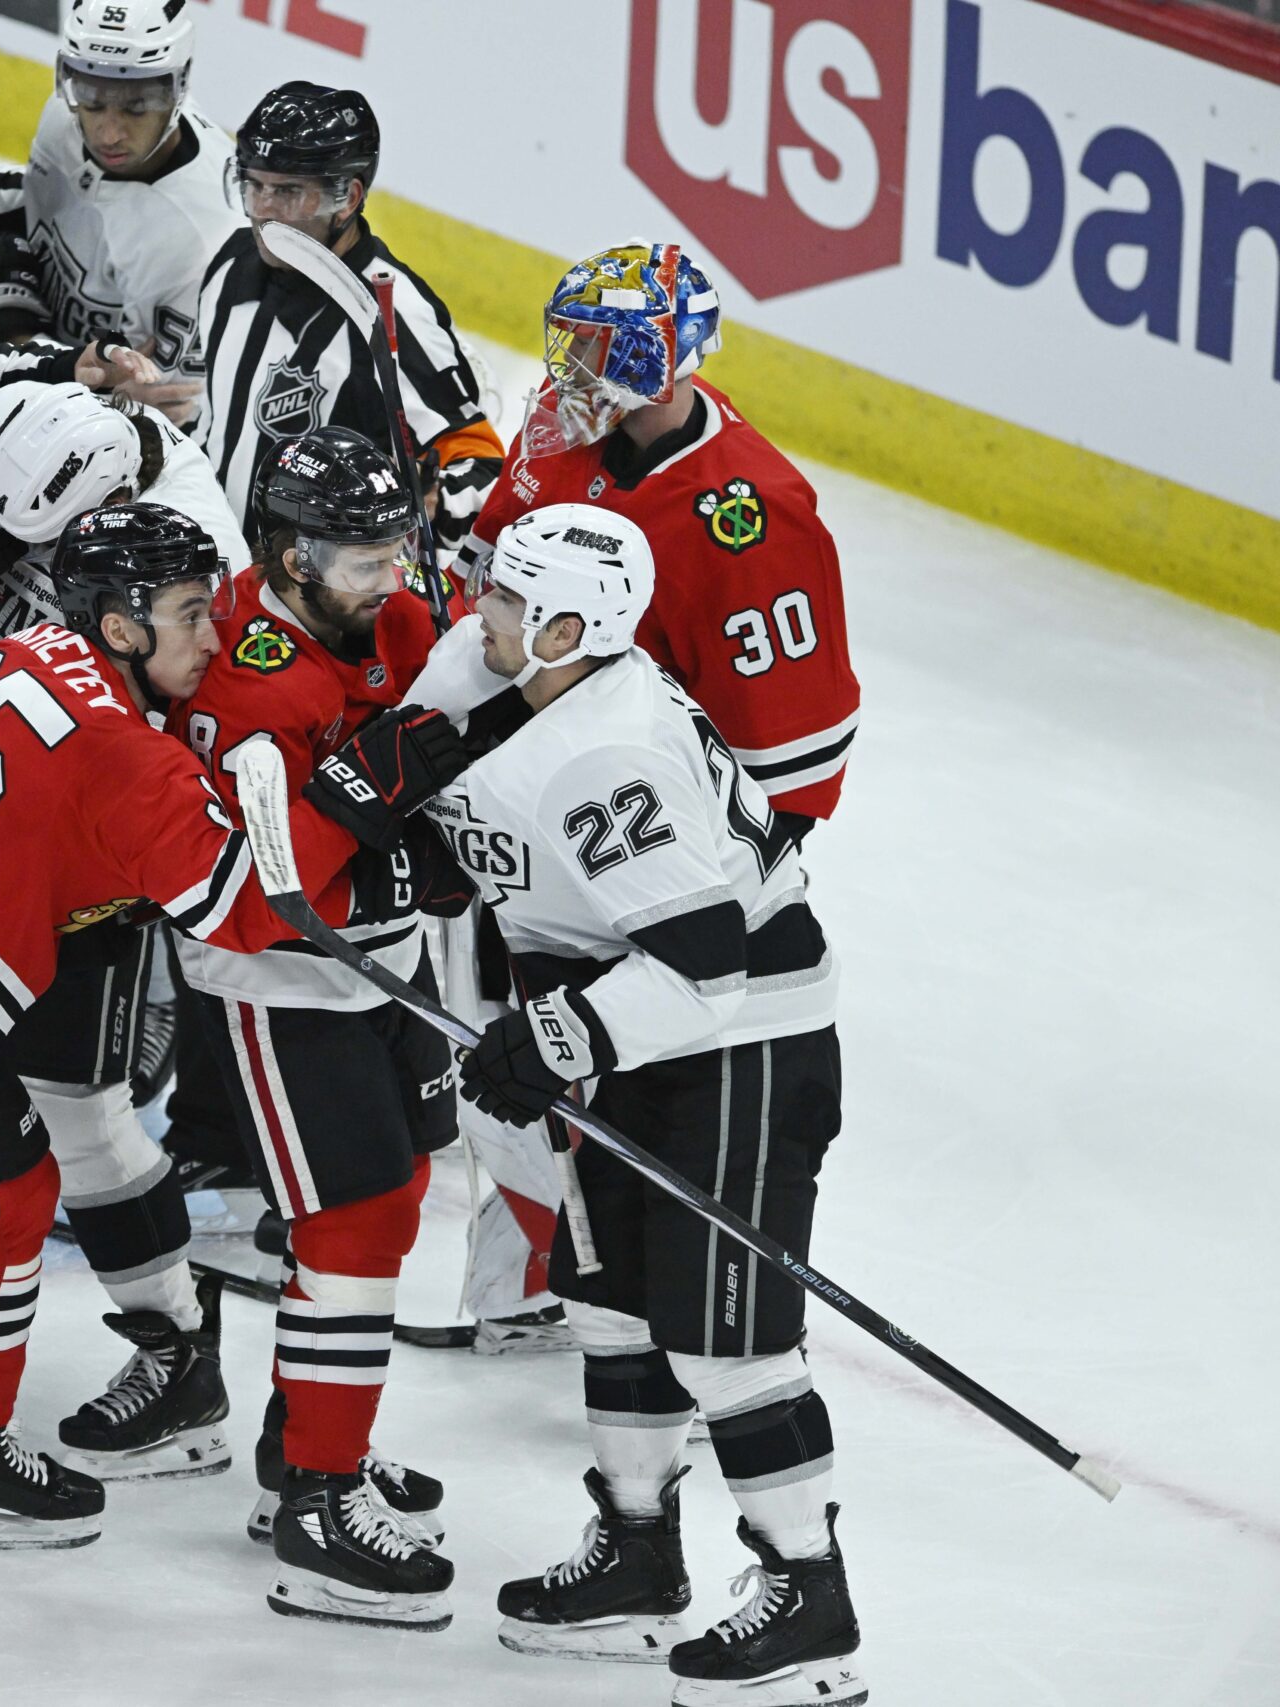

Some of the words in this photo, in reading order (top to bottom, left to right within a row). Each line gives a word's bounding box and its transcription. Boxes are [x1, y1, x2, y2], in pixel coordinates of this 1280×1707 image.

[102, 6, 128, 23] 55
[89, 43, 129, 55] CCM
[653, 0, 882, 231] us
[265, 391, 309, 420] NHL
[294, 464, 321, 479] TIRE
[297, 453, 329, 473] BELLE
[510, 457, 541, 492] Circa
[101, 519, 129, 529] TIRE
[376, 505, 409, 523] CCM
[562, 527, 624, 555] KINGS
[724, 588, 819, 678] 30
[423, 799, 462, 820] Angeles
[563, 779, 677, 881] 22
[112, 996, 127, 1055] CCM
[725, 1262, 739, 1328] BAUER
[791, 1264, 851, 1307] BAUER
